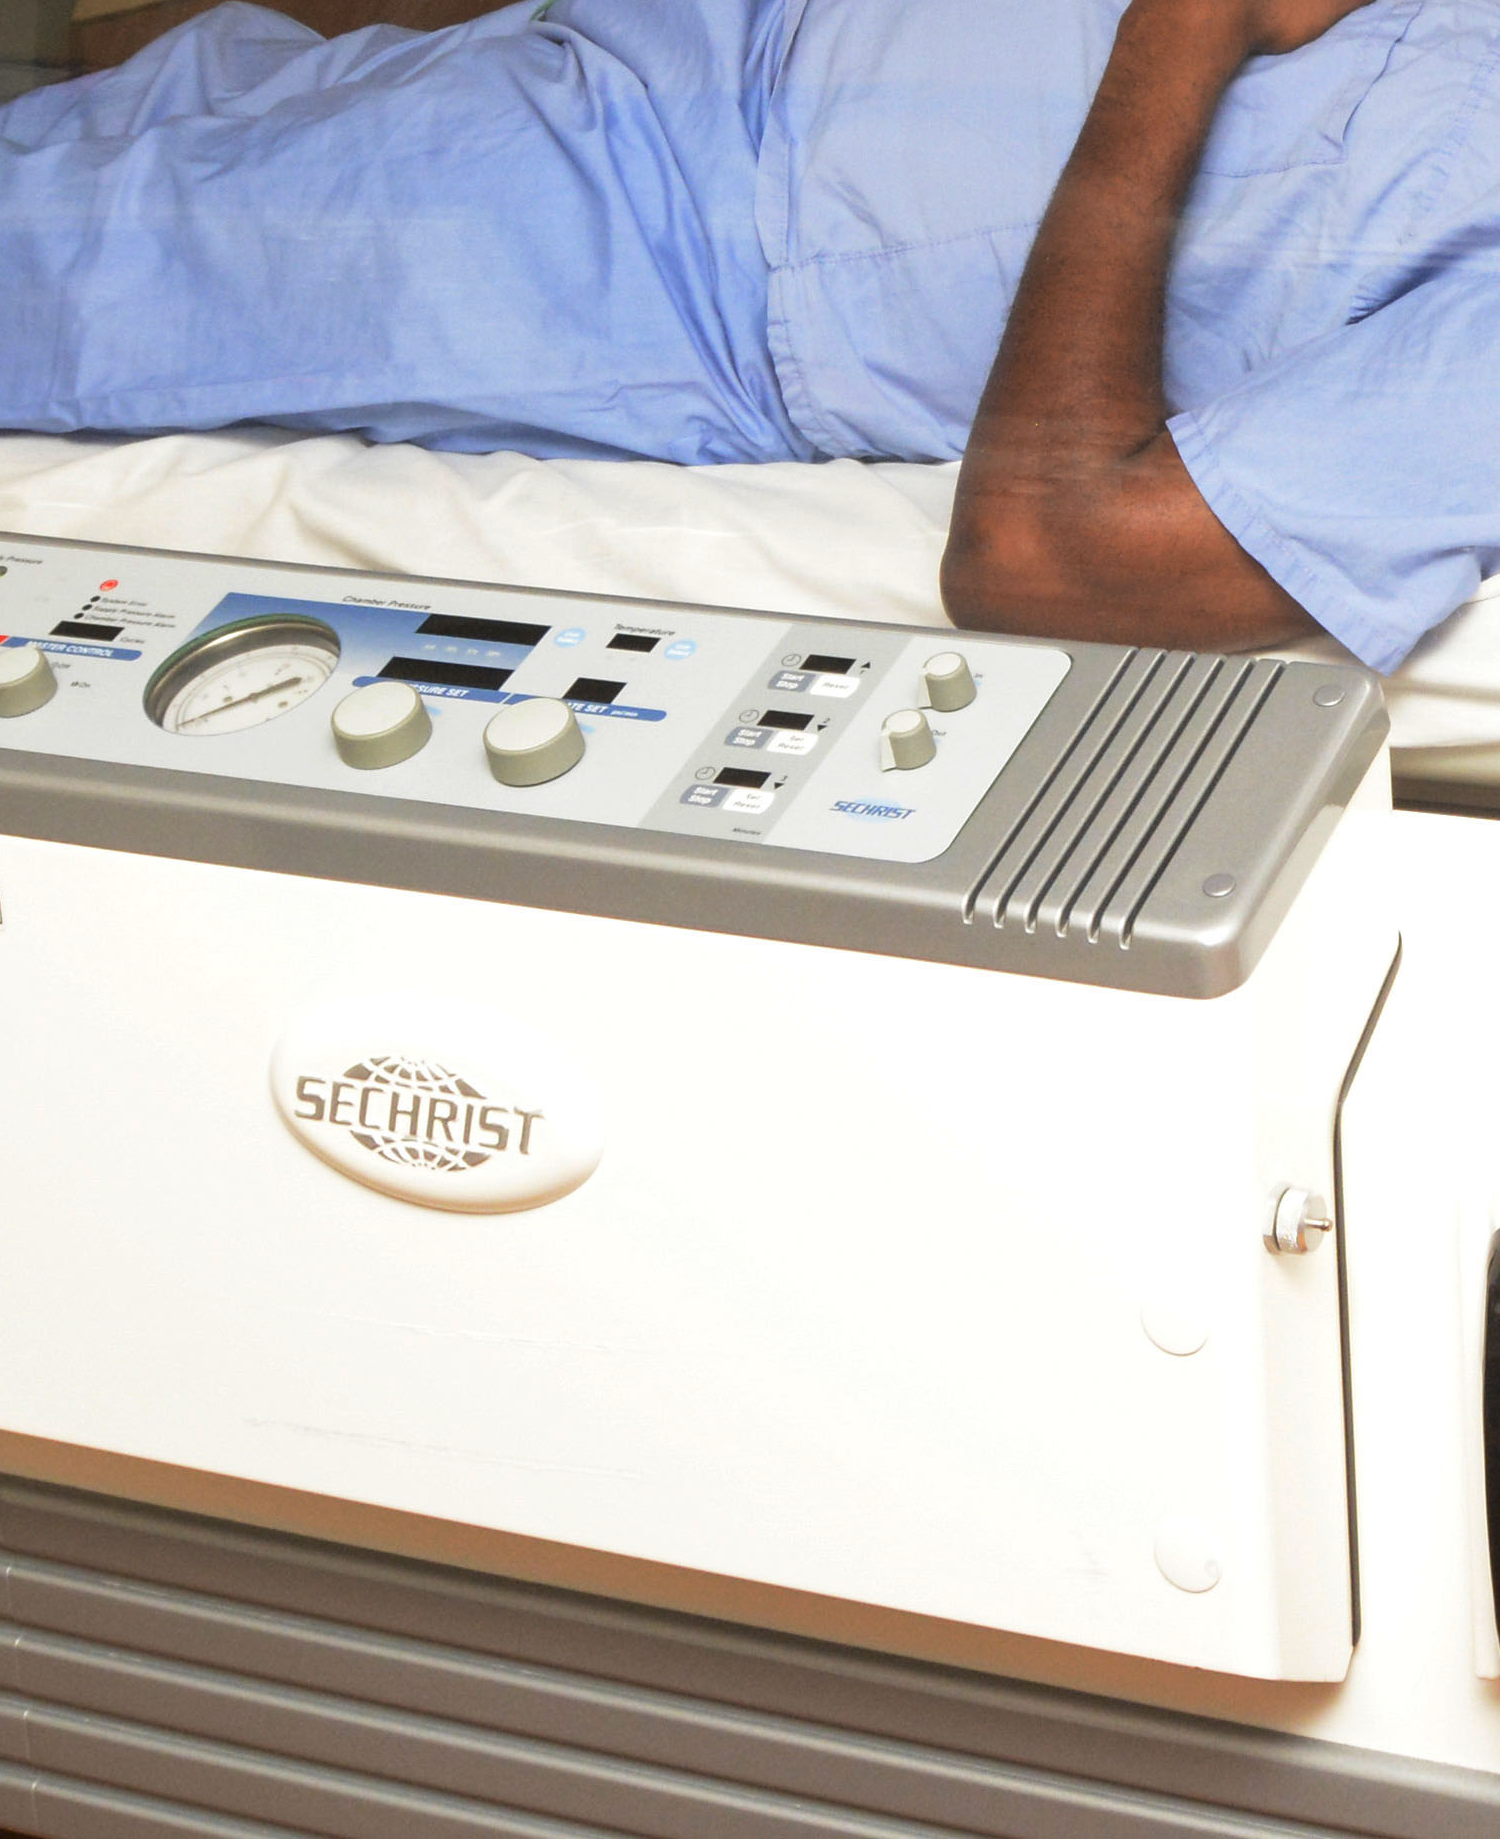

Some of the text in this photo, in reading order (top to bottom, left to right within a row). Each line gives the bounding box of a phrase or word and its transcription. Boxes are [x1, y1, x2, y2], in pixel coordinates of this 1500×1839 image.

[7, 555, 43, 564] Pressure
[342, 595, 431, 610] Chamber Pressure
[614, 623, 675, 636] Temperature
[66, 645, 114, 658] CONTROL
[445, 688, 470, 698] SET
[584, 704, 610, 714] SET
[829, 799, 916, 821] SECHRIST
[294, 1075, 546, 1156] SECHRIST
